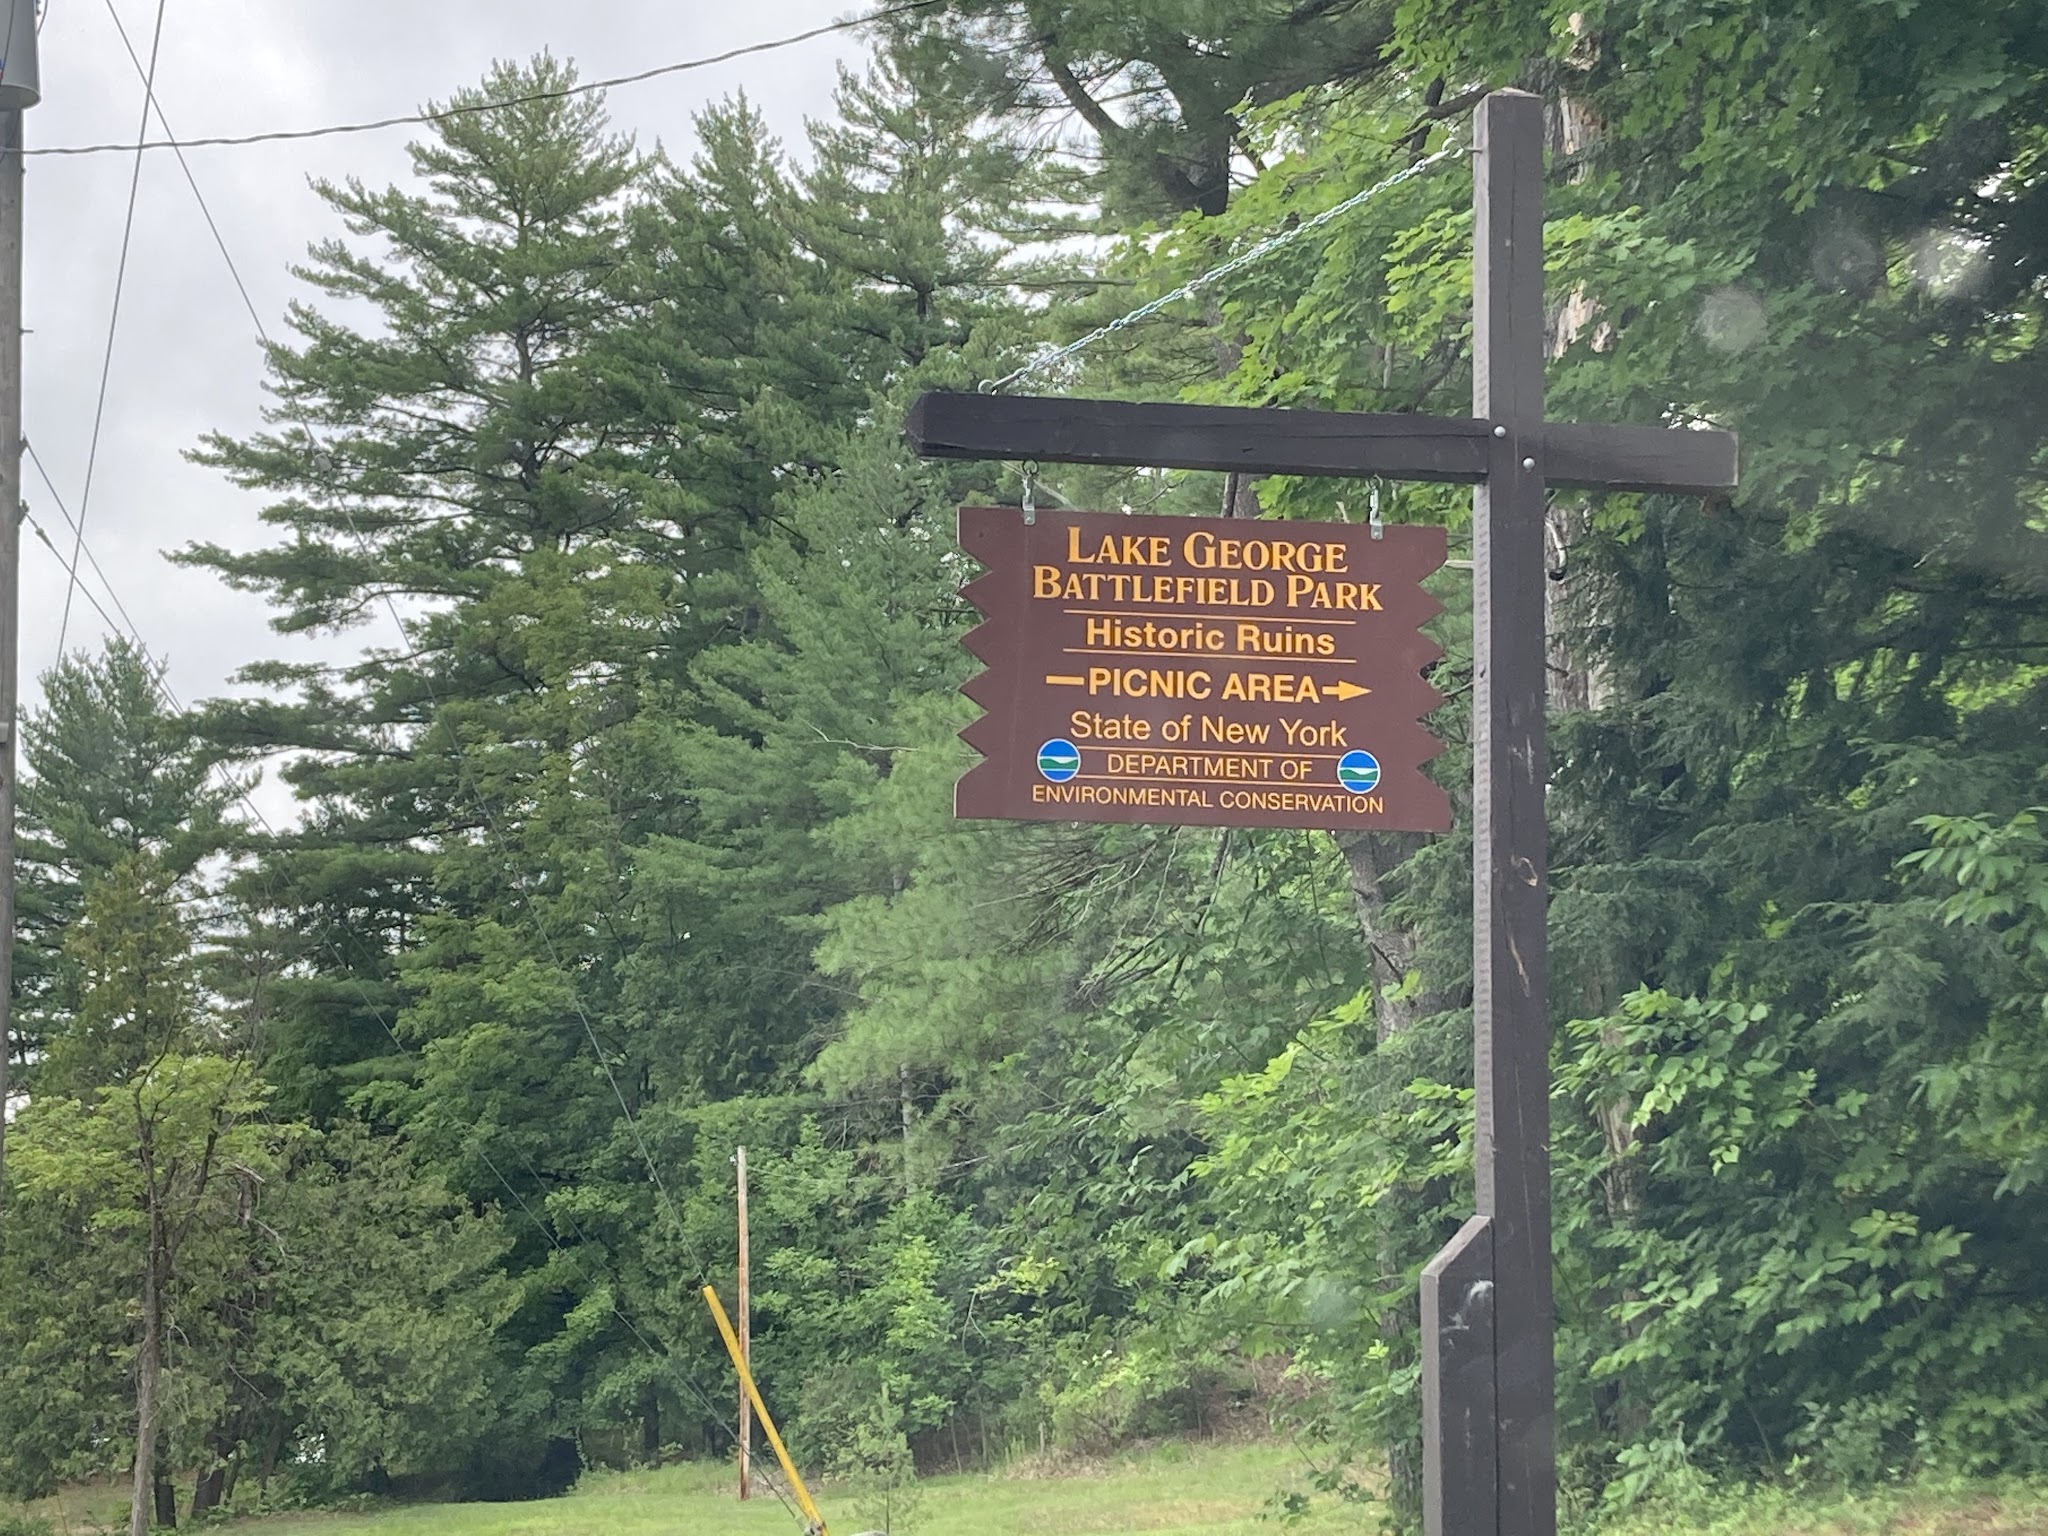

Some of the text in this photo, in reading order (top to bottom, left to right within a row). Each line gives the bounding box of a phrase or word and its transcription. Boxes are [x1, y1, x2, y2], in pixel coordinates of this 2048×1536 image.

[1068, 527, 1348, 573] LAKE GEORGE
[1033, 566, 1383, 611] BATTLEFIELD PARK
[1087, 618, 1335, 655] Historic Ruins
[1090, 668, 1320, 704] PICNIC AREA
[1070, 711, 1348, 748] State of New York
[1107, 754, 1314, 781] DEPARTMENT OF
[1032, 784, 1384, 814] ENVIRONMENTAL CONSERVATION
